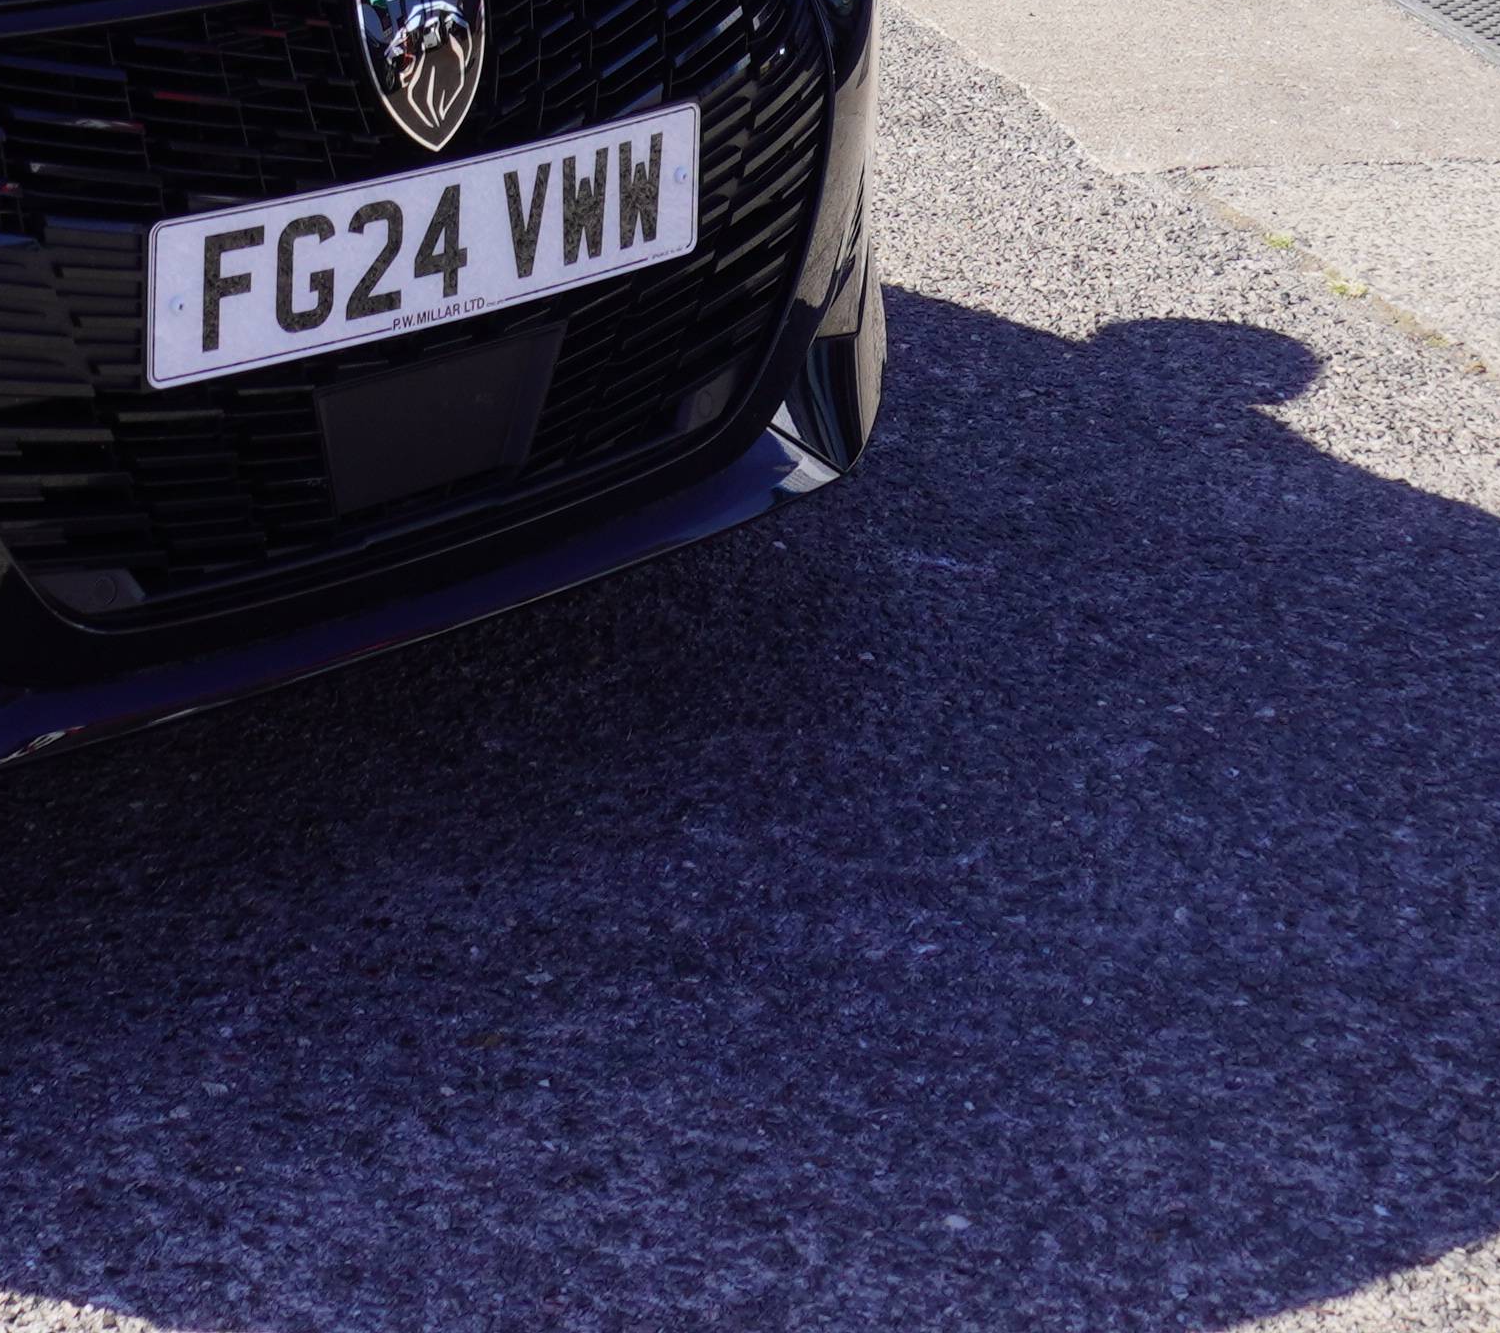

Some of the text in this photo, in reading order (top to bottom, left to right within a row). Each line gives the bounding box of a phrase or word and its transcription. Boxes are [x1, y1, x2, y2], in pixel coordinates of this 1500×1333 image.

[201, 131, 664, 353] FG24 VWW
[463, 296, 485, 314] LTD
